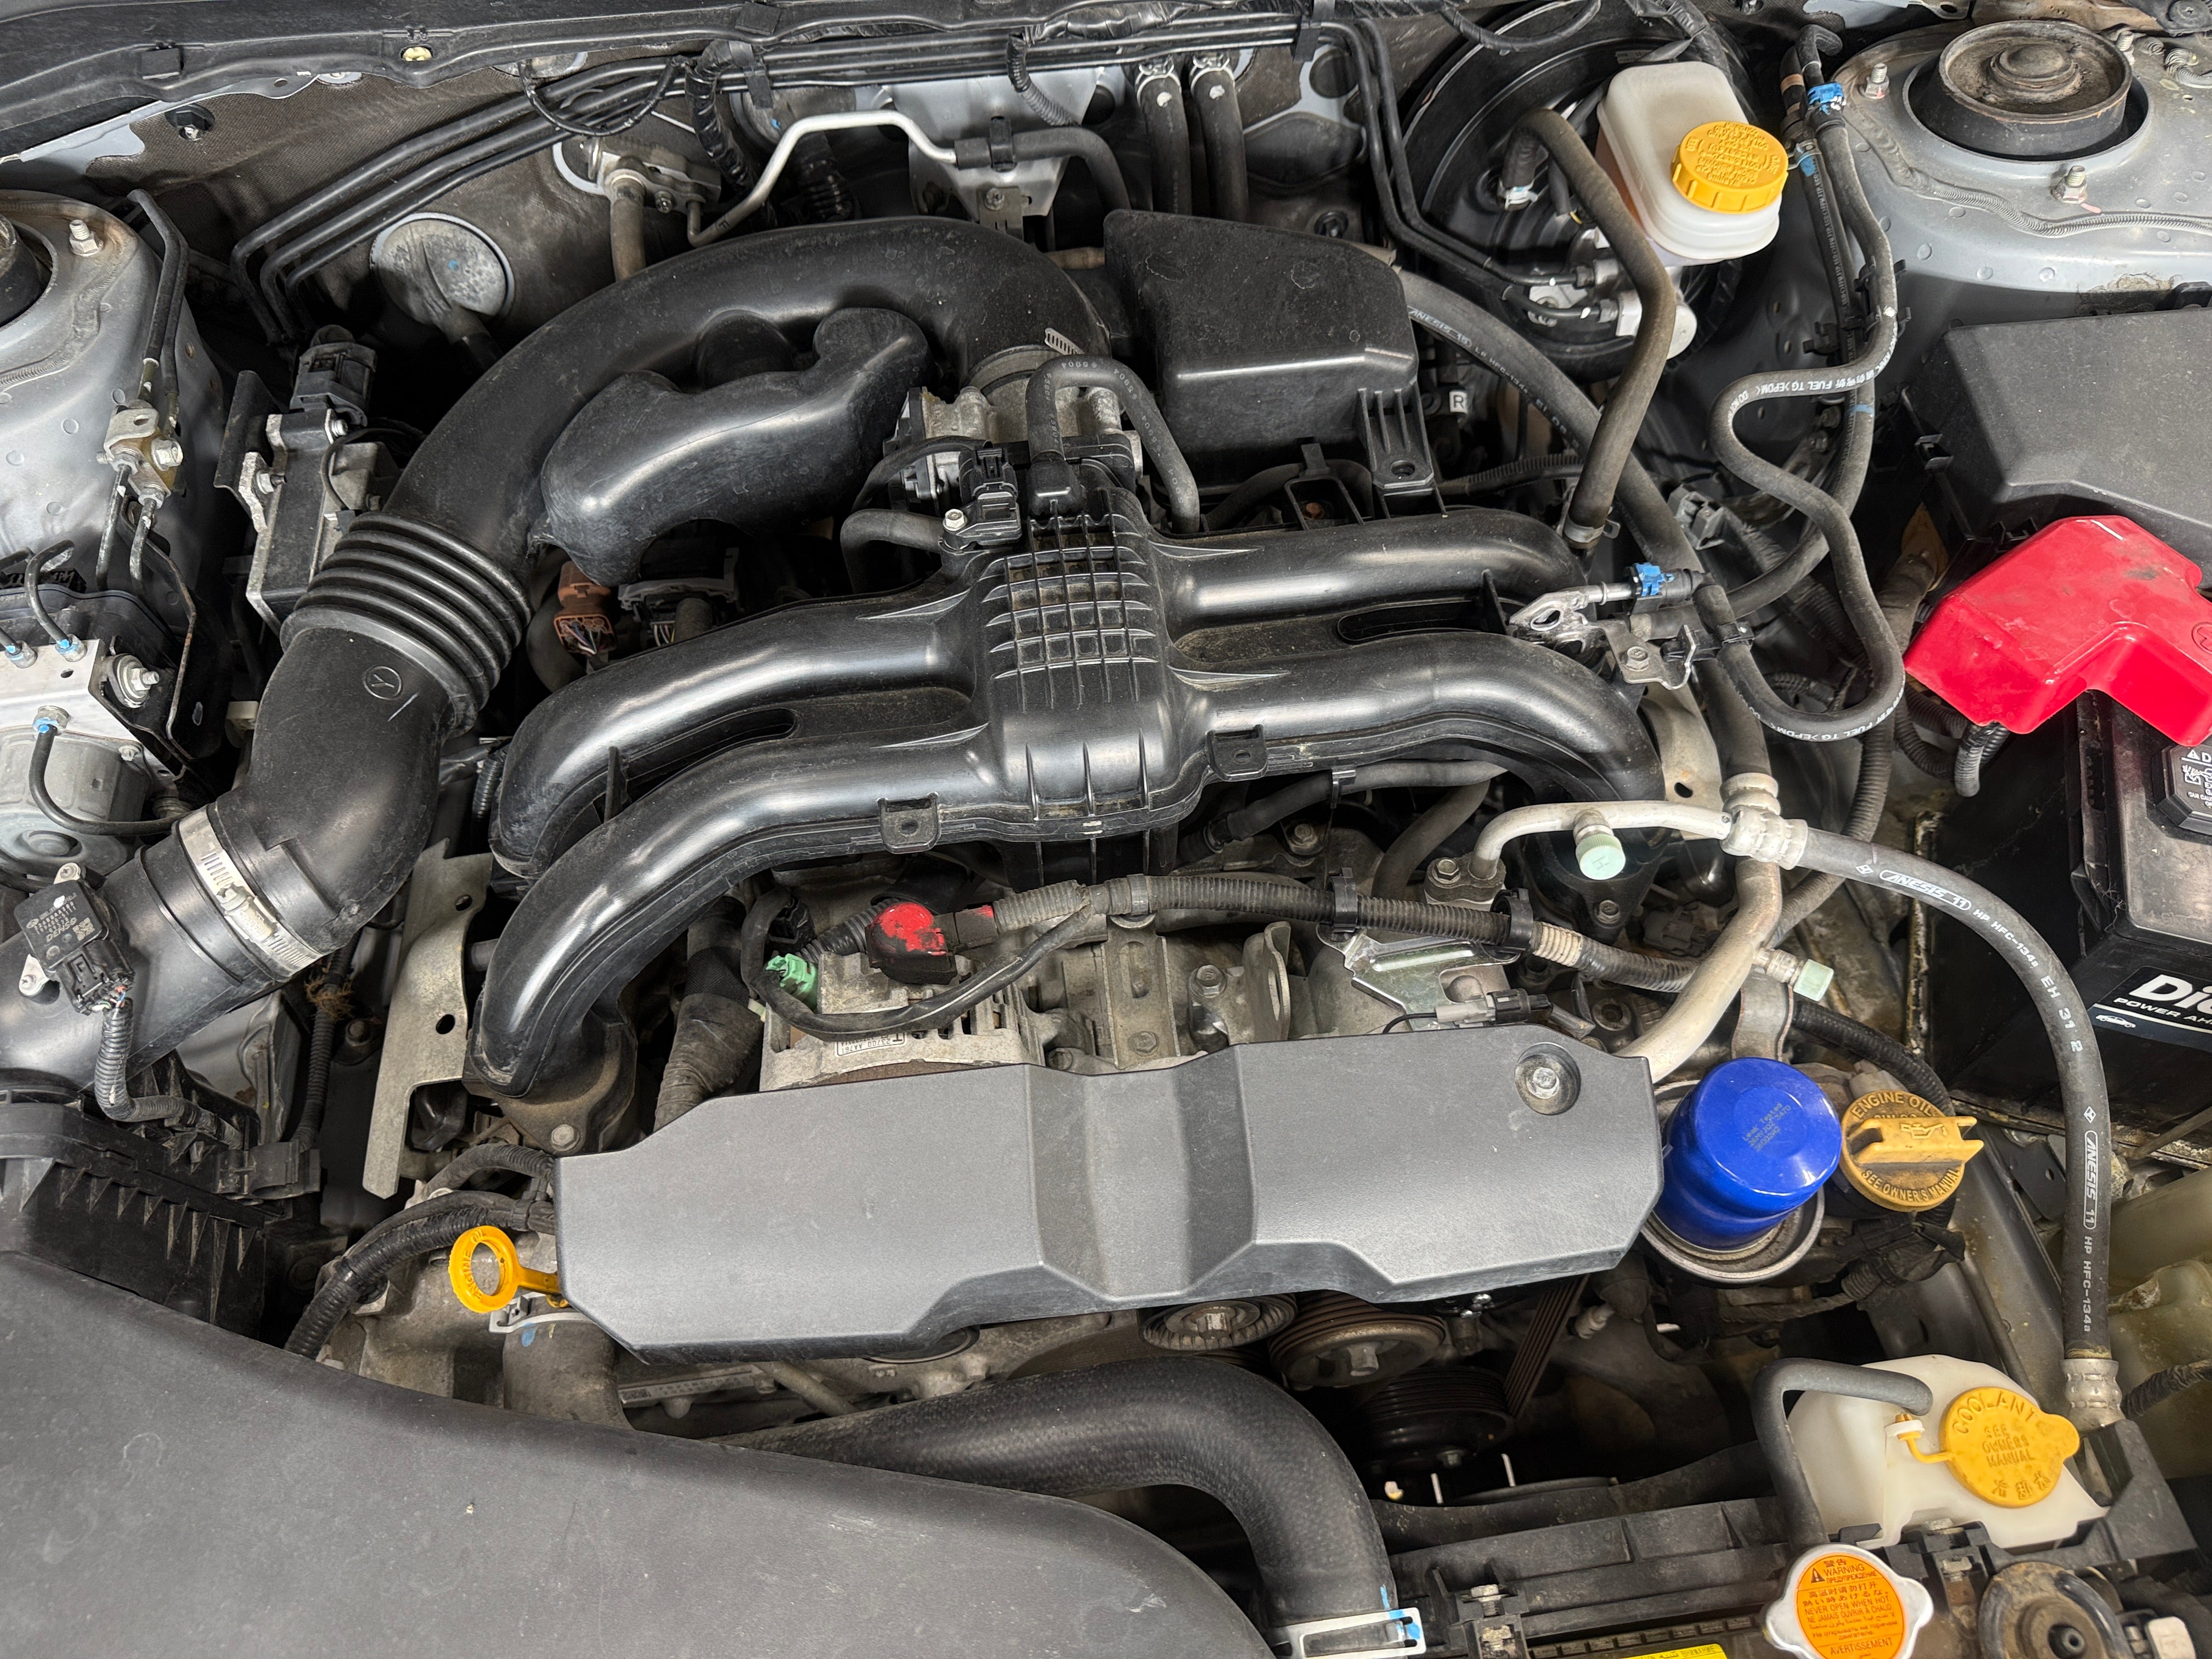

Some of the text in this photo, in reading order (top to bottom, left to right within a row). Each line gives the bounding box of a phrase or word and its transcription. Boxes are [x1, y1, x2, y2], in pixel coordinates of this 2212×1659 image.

[1791, 379, 1804, 391] TG
[1809, 380, 1832, 391] FUEL
[1843, 721, 1873, 737] FUEL
[46, 917, 77, 942] DENSO
[1889, 874, 1948, 899] ANESIS
[1951, 896, 1969, 909] 11
[1973, 909, 1990, 922] HP
[1991, 921, 2039, 967] HFC-134a
[2041, 975, 2061, 998] EH
[2058, 1007, 2075, 1029] 31
[2113, 997, 2181, 1018] POWER
[842, 1043, 862, 1053] AA761
[868, 1039, 890, 1047] 23700
[1852, 1091, 1936, 1119] ENGINE OIL
[1863, 1169, 1961, 1202] SEE OWNER'S MANUAL
[2083, 1136, 2097, 1332] ANESIS 11 HP HFC-134a
[1953, 1391, 2037, 1434] COOLANT
[1984, 1424, 2009, 1438] SEE
[1987, 1448, 2036, 1468] MANUAL
[1824, 1564, 1865, 1576] WARNING
[1805, 1595, 1889, 1615] NEVER OPEN WHEN HOT
[1818, 1612, 1839, 1622] JAMAIS
[1871, 1604, 1892, 1613] CHAUD
[1831, 1637, 1893, 1655] AVERTISSEMENT
